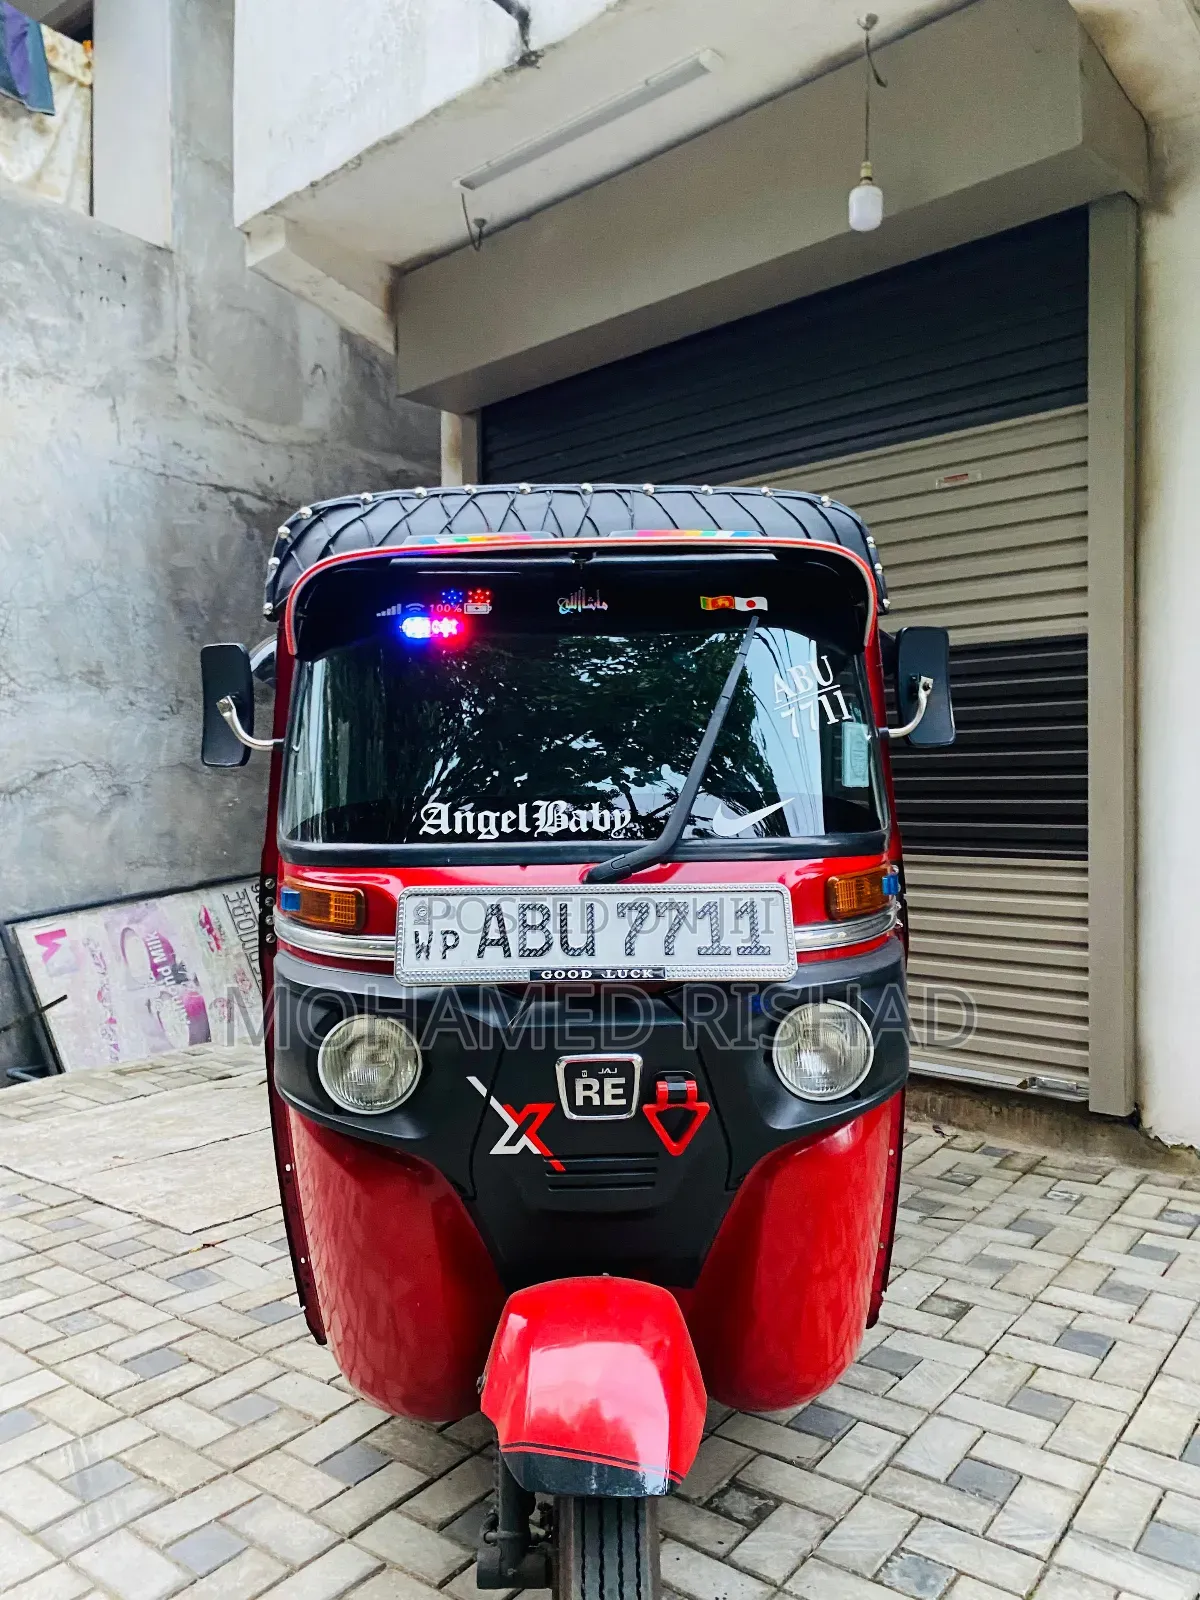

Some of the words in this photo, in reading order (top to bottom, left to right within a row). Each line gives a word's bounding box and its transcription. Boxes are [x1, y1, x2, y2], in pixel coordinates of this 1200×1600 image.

[773, 655, 834, 704] ABU
[780, 689, 853, 738] 7711
[145, 930, 168, 964] Milk
[413, 930, 460, 960] WP
[476, 903, 596, 958] ABU
[616, 901, 771, 956] 7711
[540, 970, 592, 980] GOOD
[604, 969, 654, 979] LUCK
[575, 1077, 627, 1106] RE
